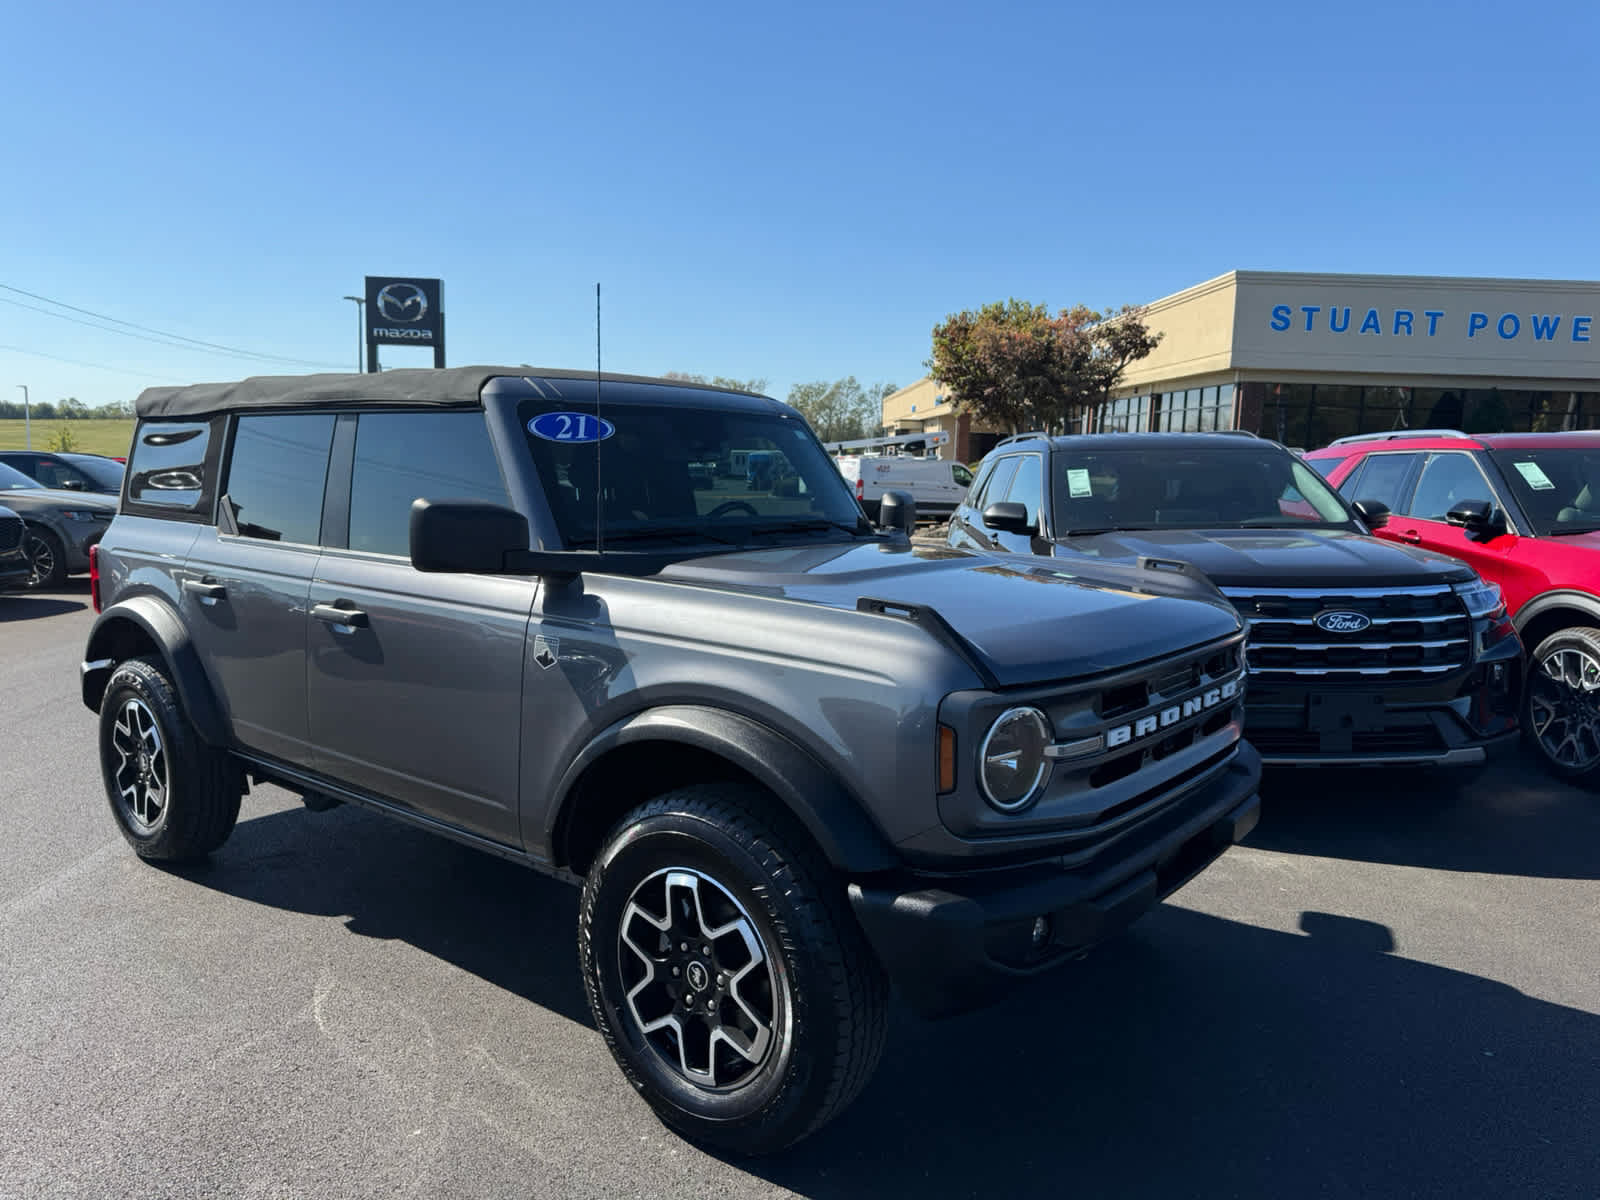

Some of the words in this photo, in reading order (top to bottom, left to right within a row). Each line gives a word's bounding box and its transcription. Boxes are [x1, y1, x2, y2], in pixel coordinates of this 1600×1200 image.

[373, 327, 432, 339] mazda
[1269, 304, 1445, 337] STUART
[1467, 312, 1593, 343] POWE
[555, 415, 588, 439] 21
[1326, 614, 1361, 629] Ford
[1107, 680, 1238, 748] BRONCO
